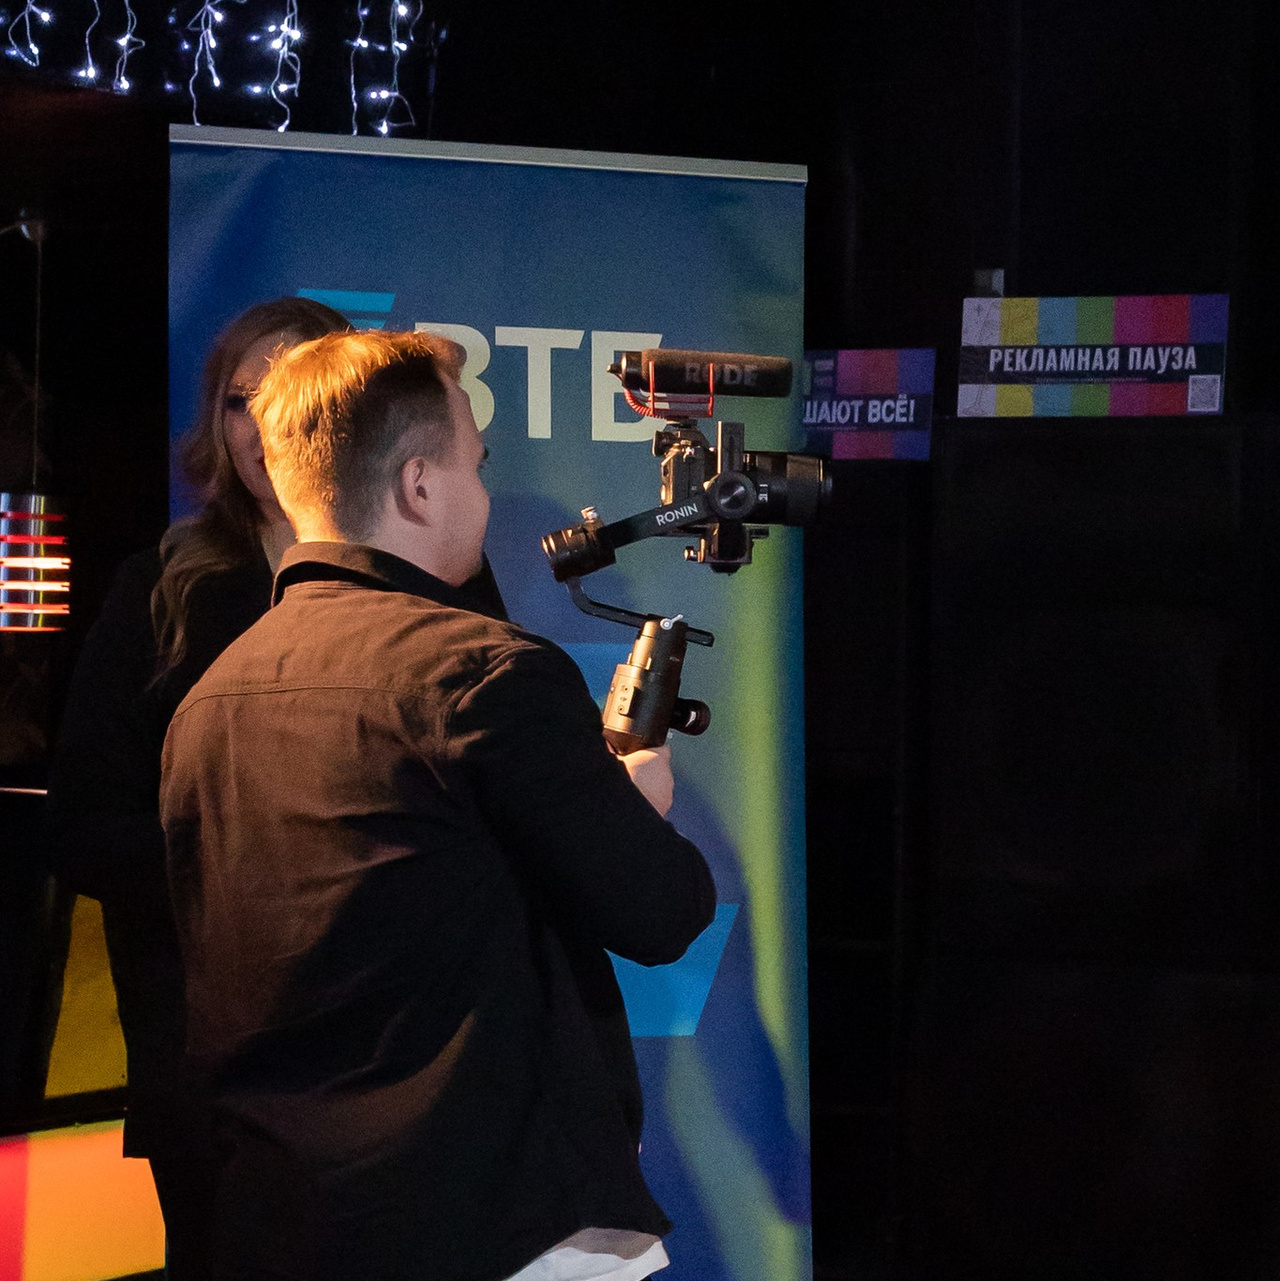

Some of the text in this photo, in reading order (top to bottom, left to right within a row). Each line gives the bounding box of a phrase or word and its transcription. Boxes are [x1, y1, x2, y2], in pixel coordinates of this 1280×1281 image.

[988, 346, 1197, 374] РЕКЛАМНАЯ ПАУЗА
[867, 393, 915, 424] ВСЁ!
[655, 503, 698, 526] RONIN
